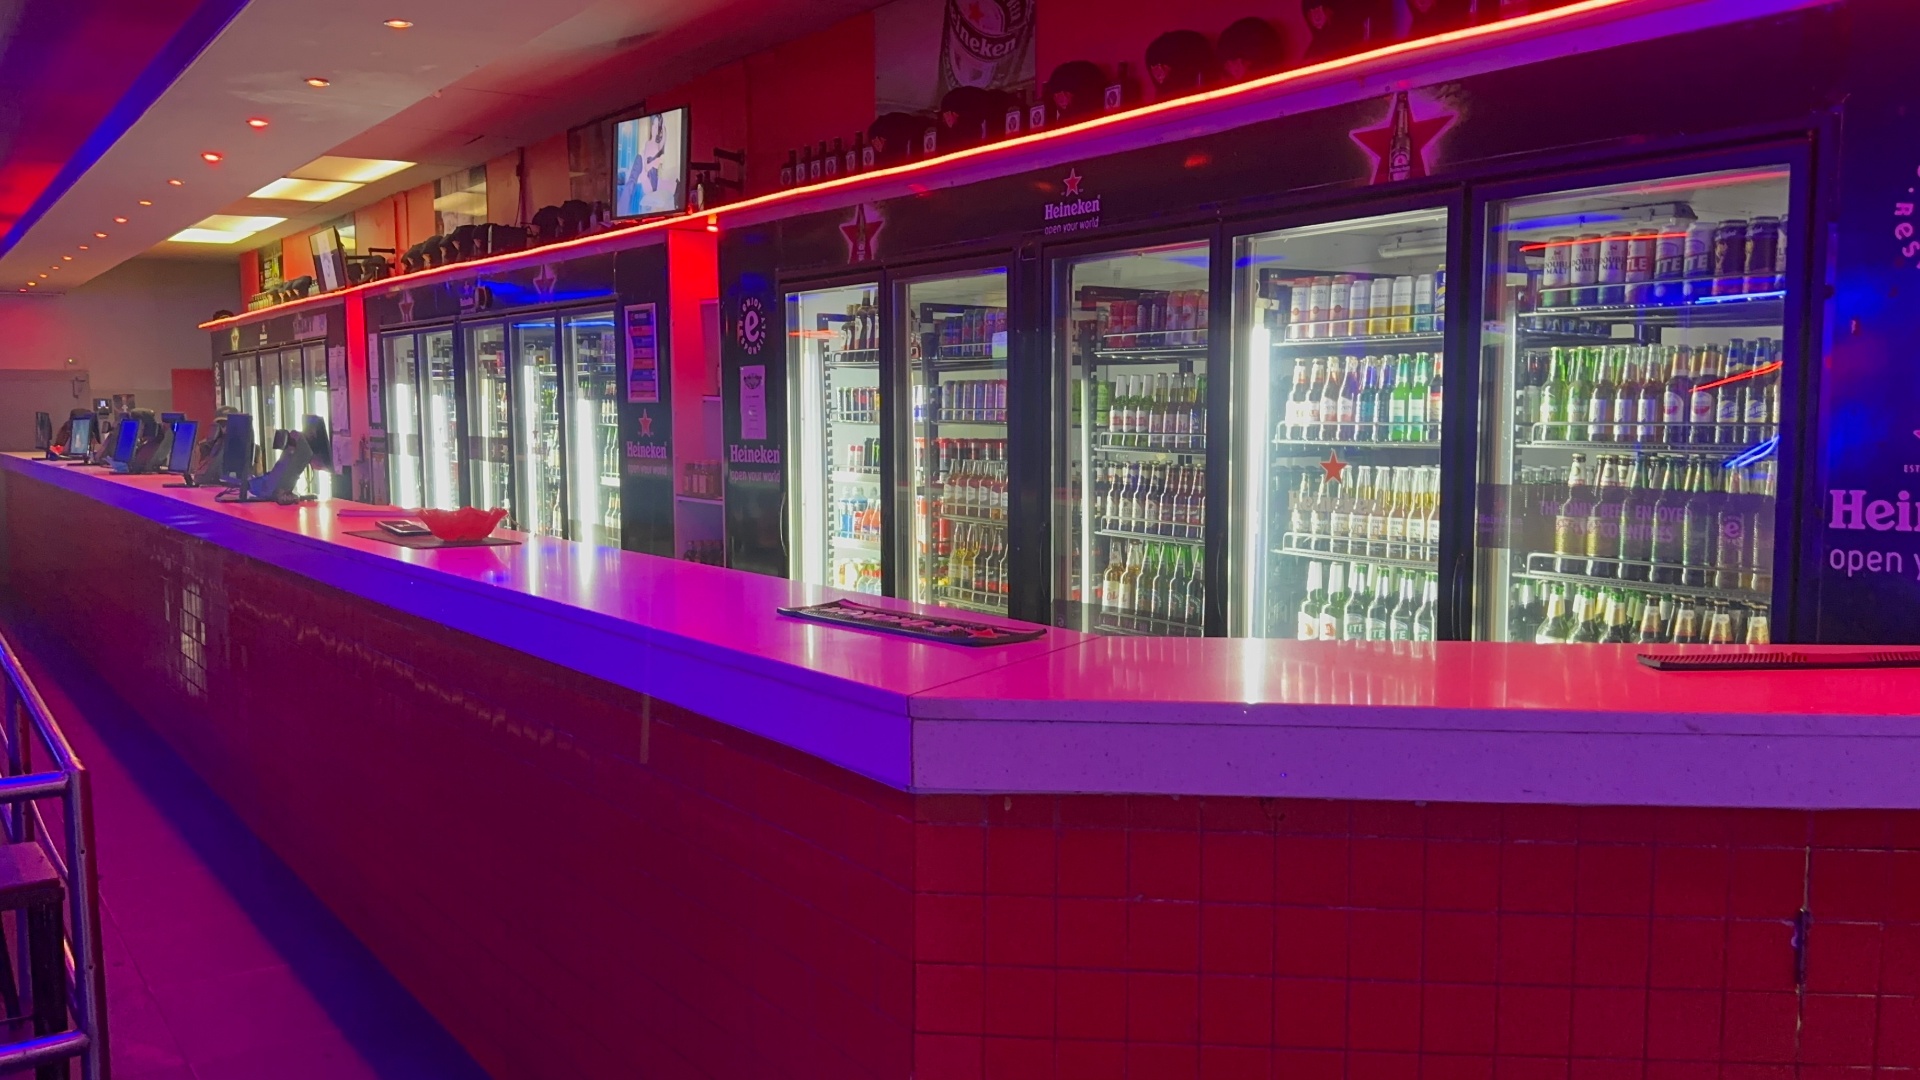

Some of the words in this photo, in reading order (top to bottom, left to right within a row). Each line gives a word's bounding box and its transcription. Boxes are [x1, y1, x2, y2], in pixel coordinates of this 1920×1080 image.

[1045, 198, 1100, 220] Heineken
[1080, 216, 1099, 229] world
[627, 441, 667, 459] Heineken
[730, 444, 780, 464] Heineken
[1829, 548, 1903, 578] open
